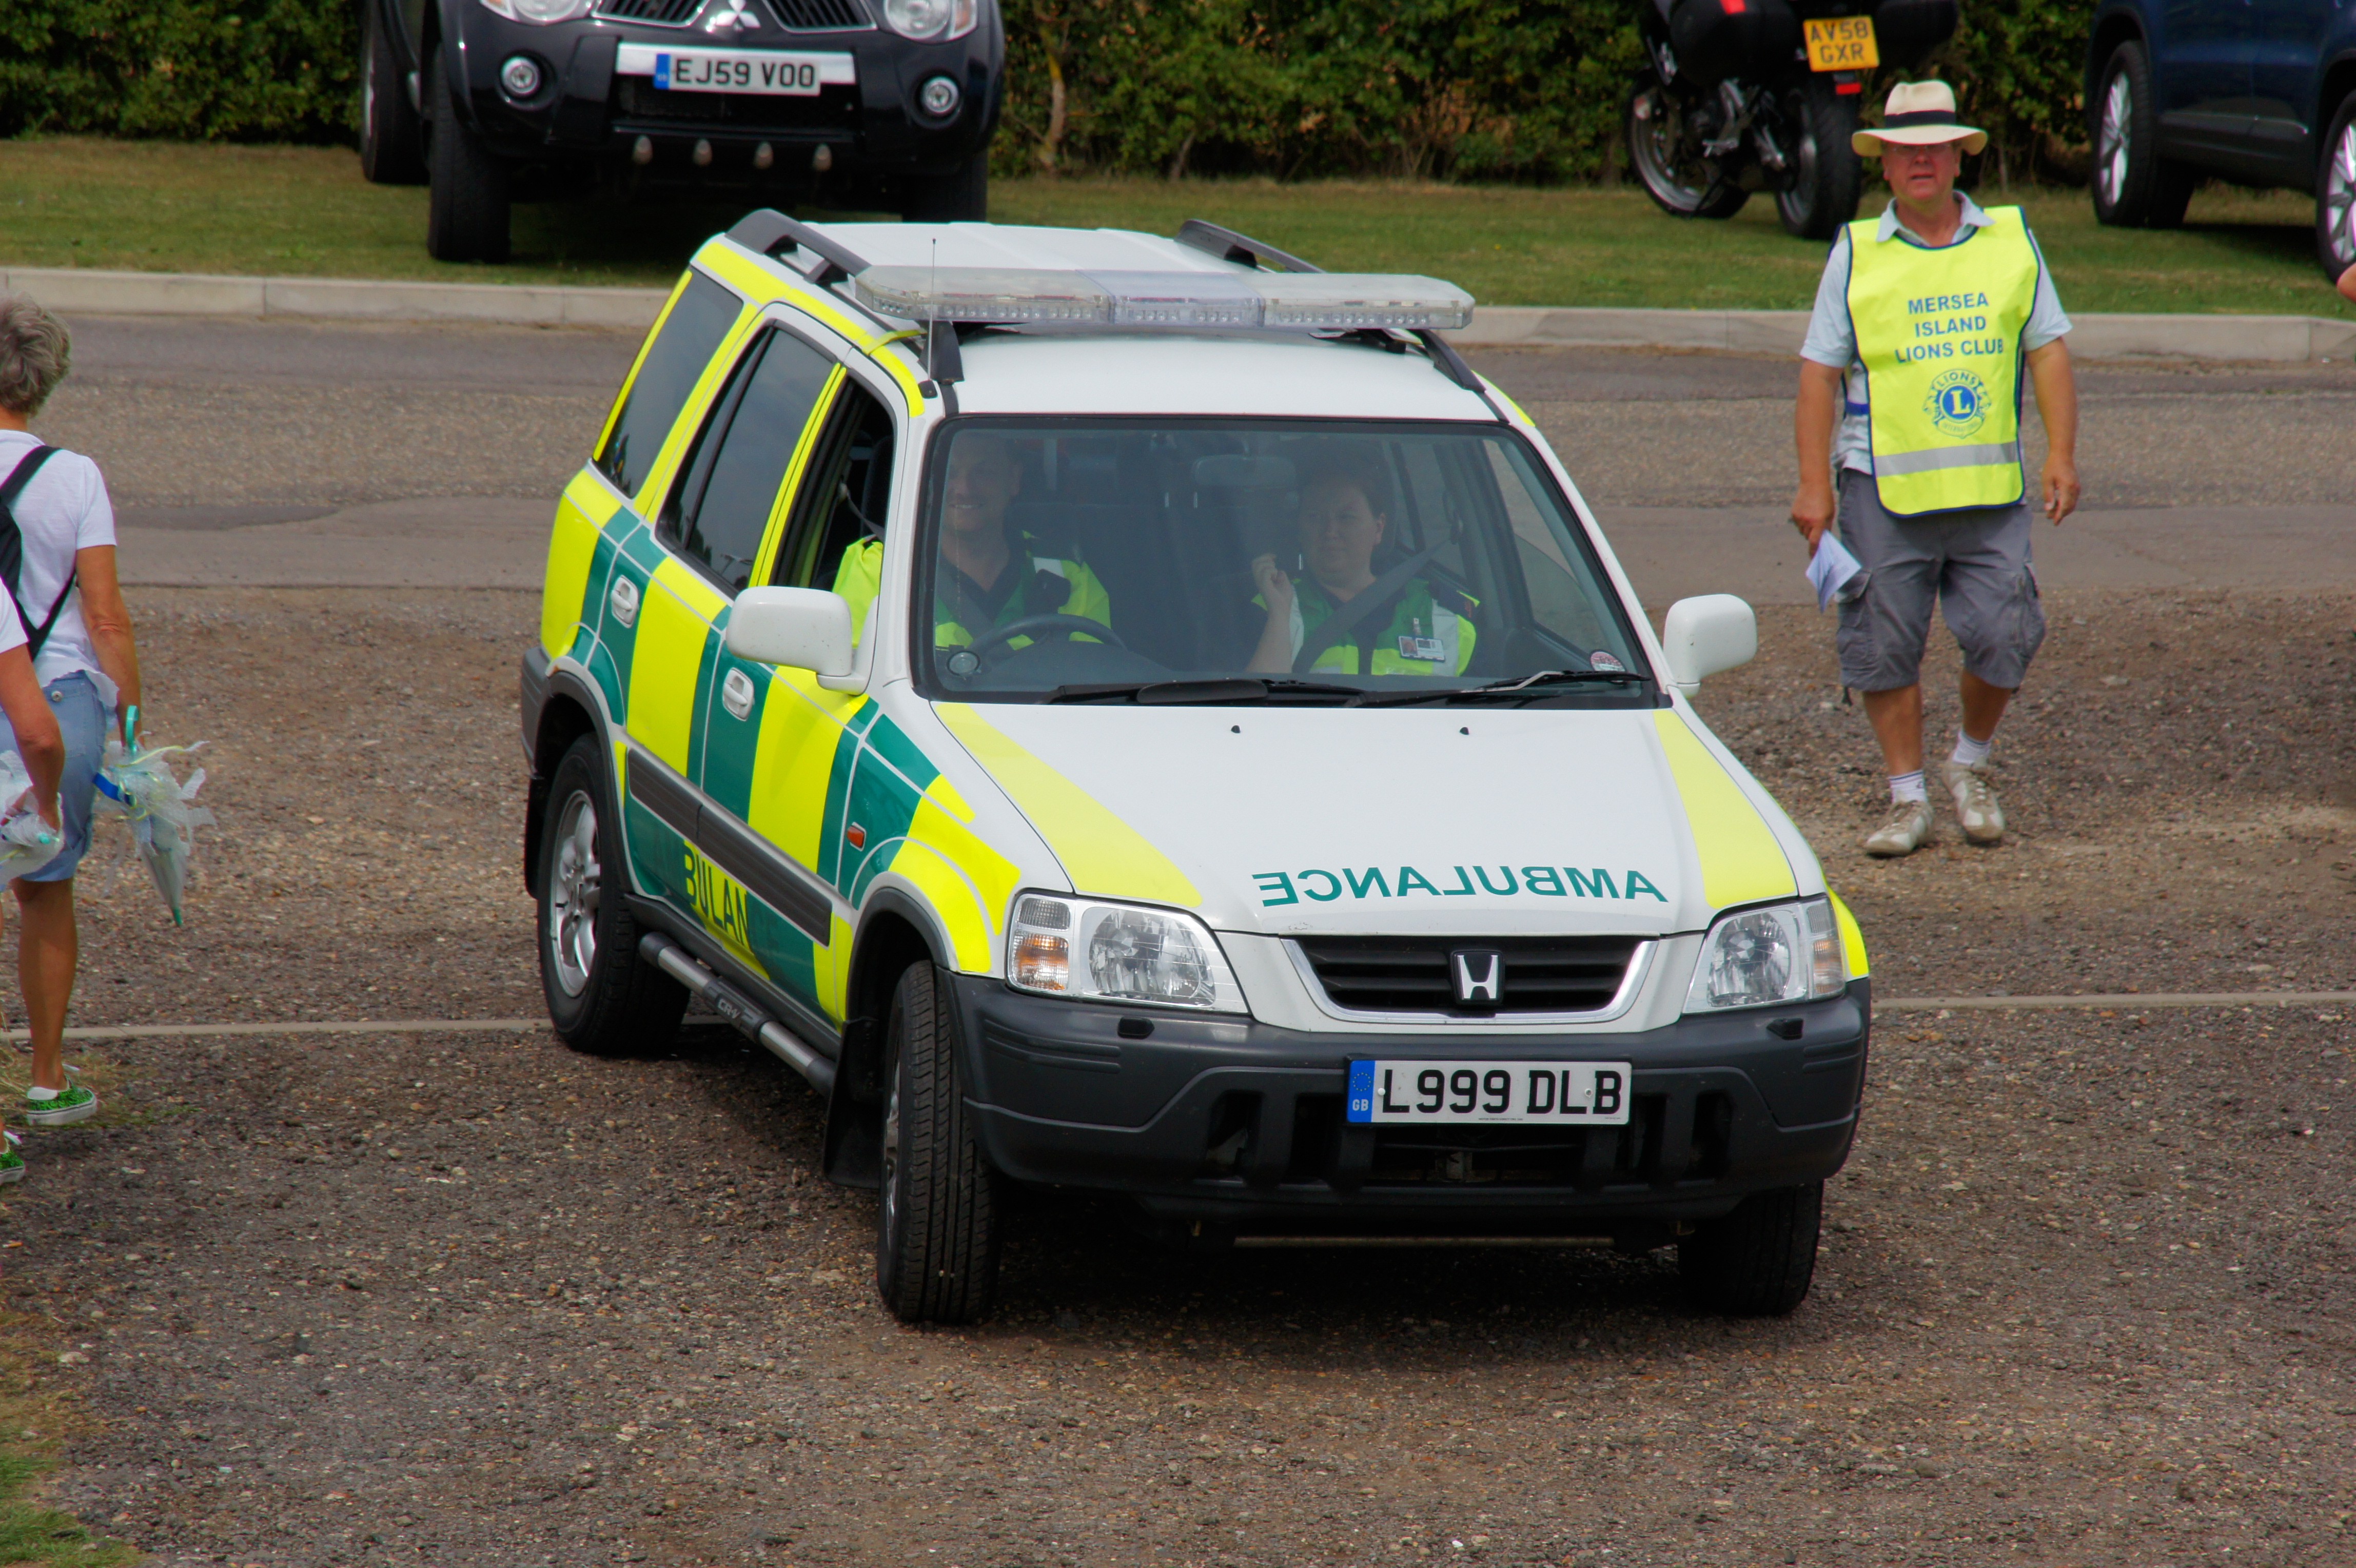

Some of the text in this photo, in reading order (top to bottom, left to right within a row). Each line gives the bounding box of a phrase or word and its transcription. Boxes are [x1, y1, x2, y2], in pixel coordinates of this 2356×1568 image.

[675, 59, 816, 88] EJ59 VOO
[1908, 292, 1989, 315] MERSEA
[1915, 316, 1987, 338] ISLAND
[1895, 338, 2004, 363] LIONS CLUB
[1936, 371, 1977, 386] LIONS
[1950, 389, 1971, 415] L
[1382, 1069, 1622, 1114] L999 DLB
[1352, 1099, 1369, 1111] GB
